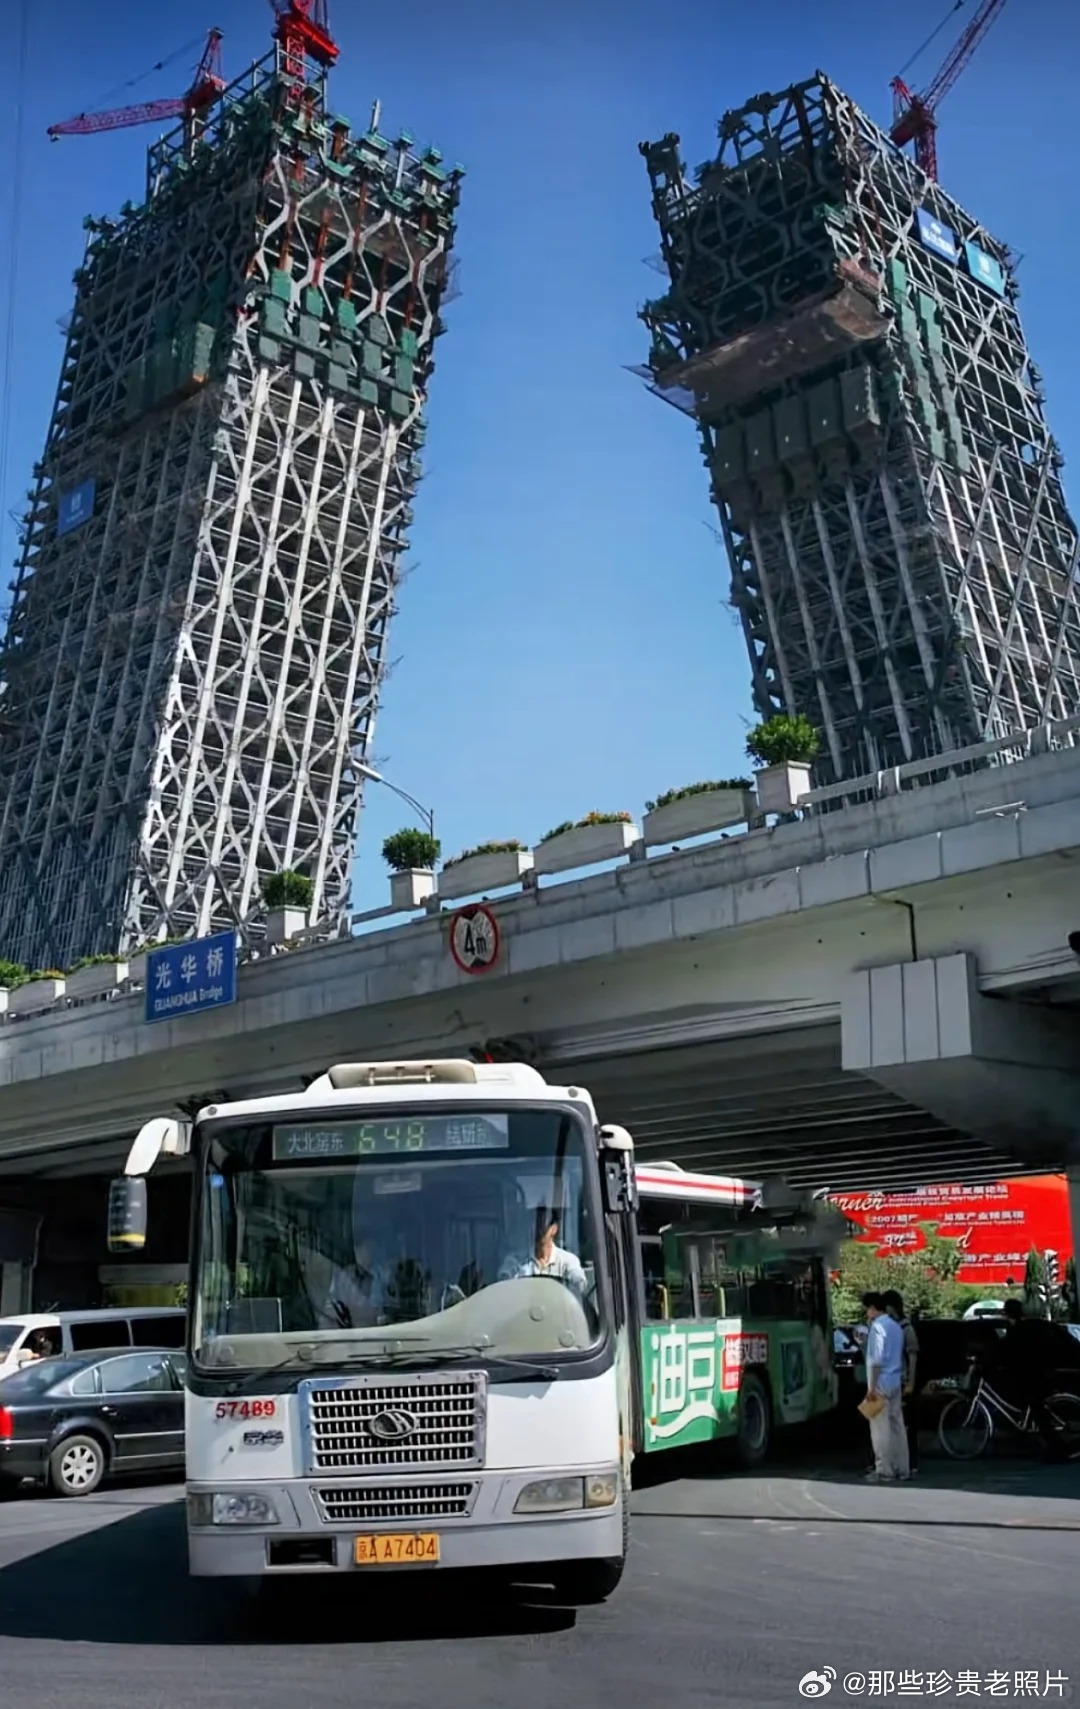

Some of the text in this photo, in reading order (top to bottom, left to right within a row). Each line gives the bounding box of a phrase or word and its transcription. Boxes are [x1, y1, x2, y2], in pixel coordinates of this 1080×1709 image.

[464, 923, 487, 956] 4m
[155, 946, 224, 991] 光华桥
[154, 989, 198, 1013] GUANGHUA
[359, 1121, 425, 1154] 648
[215, 1400, 275, 1419] 57489
